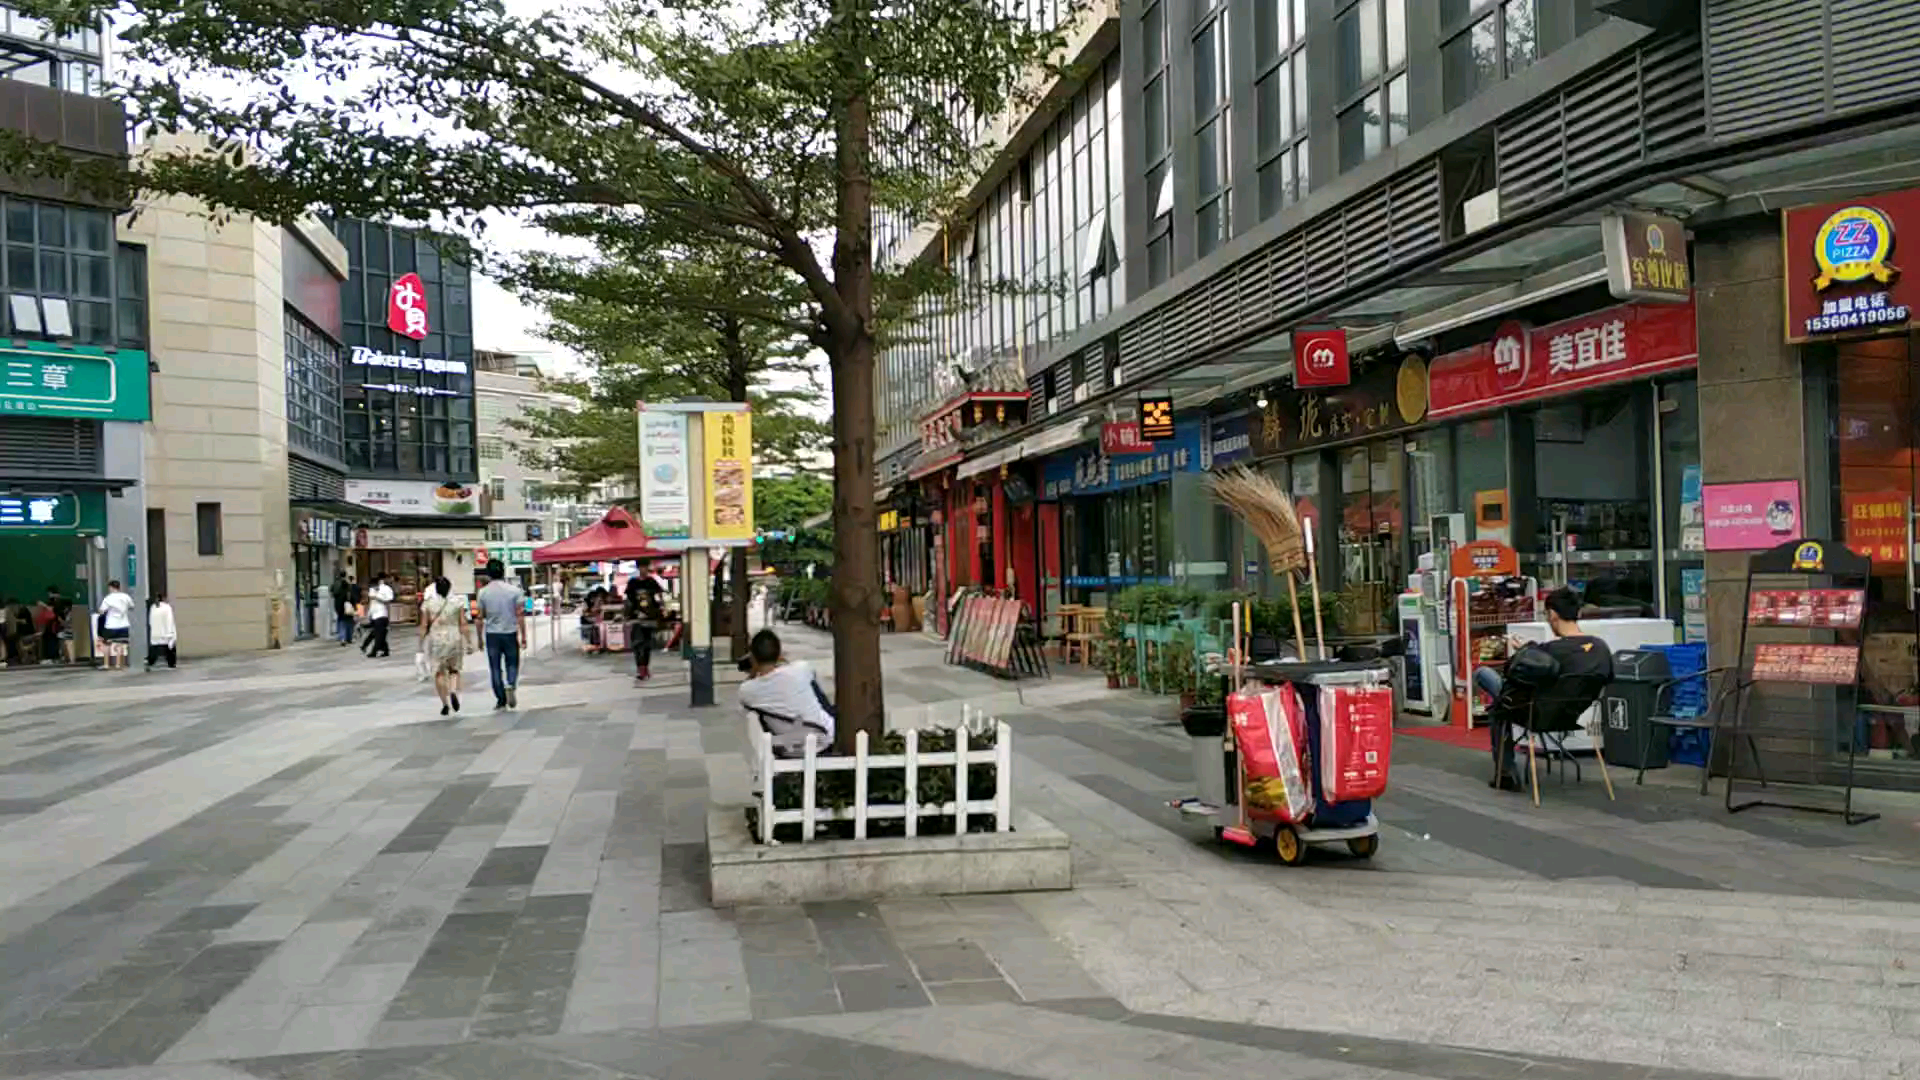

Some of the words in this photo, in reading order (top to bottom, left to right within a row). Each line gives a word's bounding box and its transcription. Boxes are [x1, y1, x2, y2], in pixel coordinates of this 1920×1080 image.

[1832, 245, 1870, 259] PIZZA
[1549, 319, 1627, 375] 美宜佳
[6, 362, 69, 391] 三章
